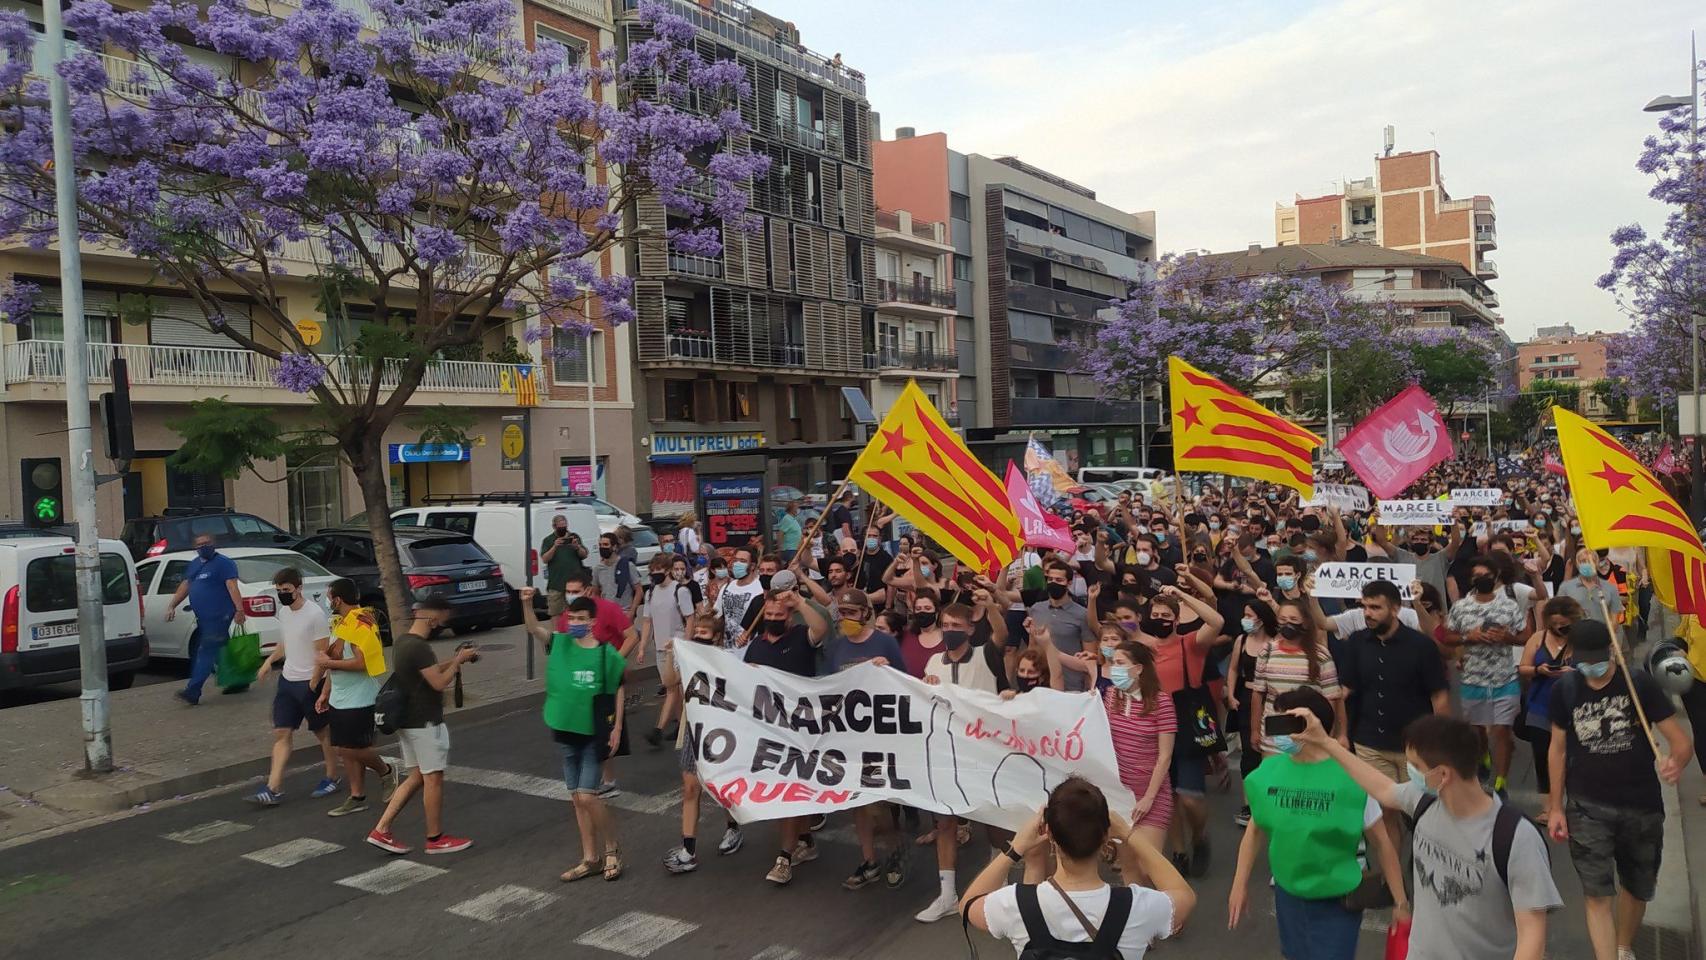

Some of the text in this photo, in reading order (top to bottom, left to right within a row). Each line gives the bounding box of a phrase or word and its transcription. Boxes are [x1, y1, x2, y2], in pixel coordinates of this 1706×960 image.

[654, 436, 733, 452] MULTIPREU
[1316, 484, 1358, 497] ARCEL
[1383, 503, 1443, 512] MARCEL
[1319, 567, 1399, 581] MARCEL
[39, 626, 64, 637] 0316
[684, 670, 923, 735] AL MARCEL
[686, 721, 912, 790] NO ENS EL
